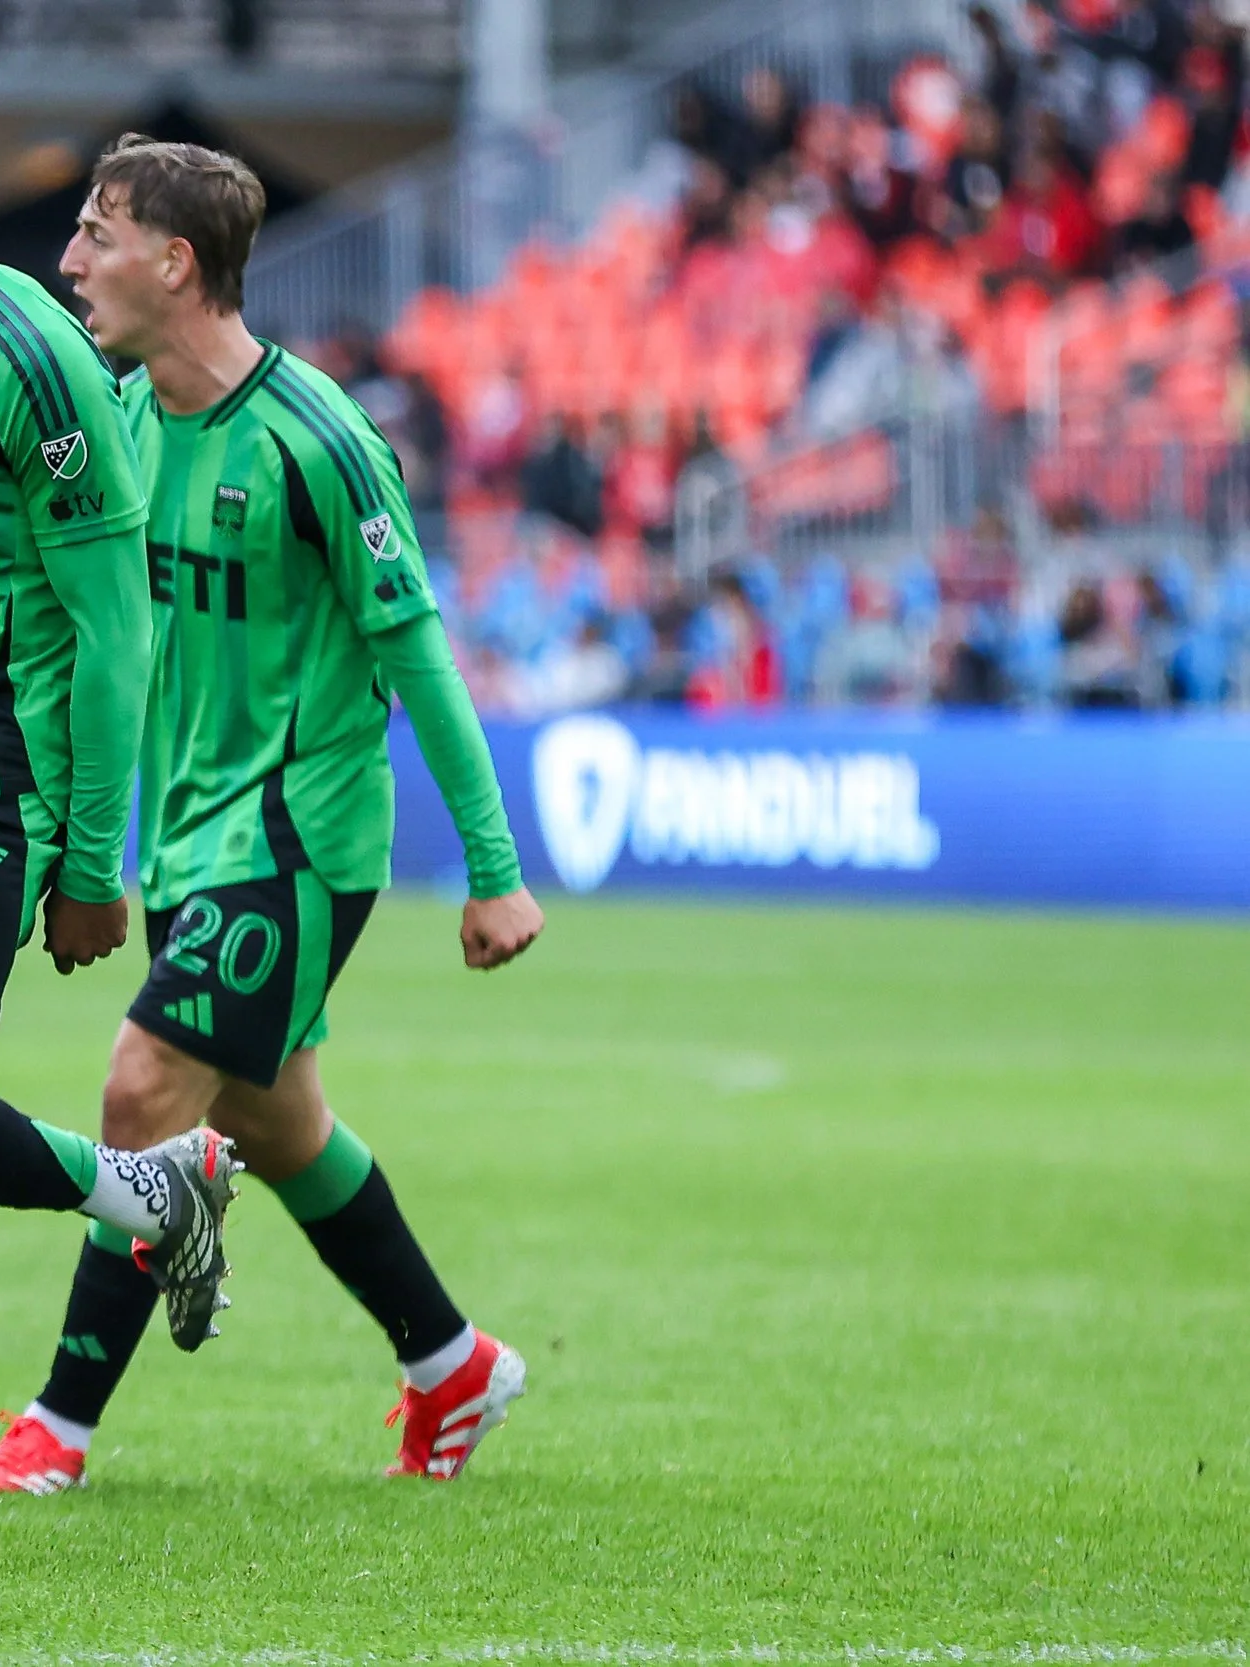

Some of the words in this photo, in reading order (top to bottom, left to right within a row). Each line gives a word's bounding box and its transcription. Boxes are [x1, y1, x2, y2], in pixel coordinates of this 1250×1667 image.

[44, 440, 69, 455] MLS
[74, 492, 104, 516] tv
[147, 540, 247, 620] ETI
[166, 896, 282, 996] 20
